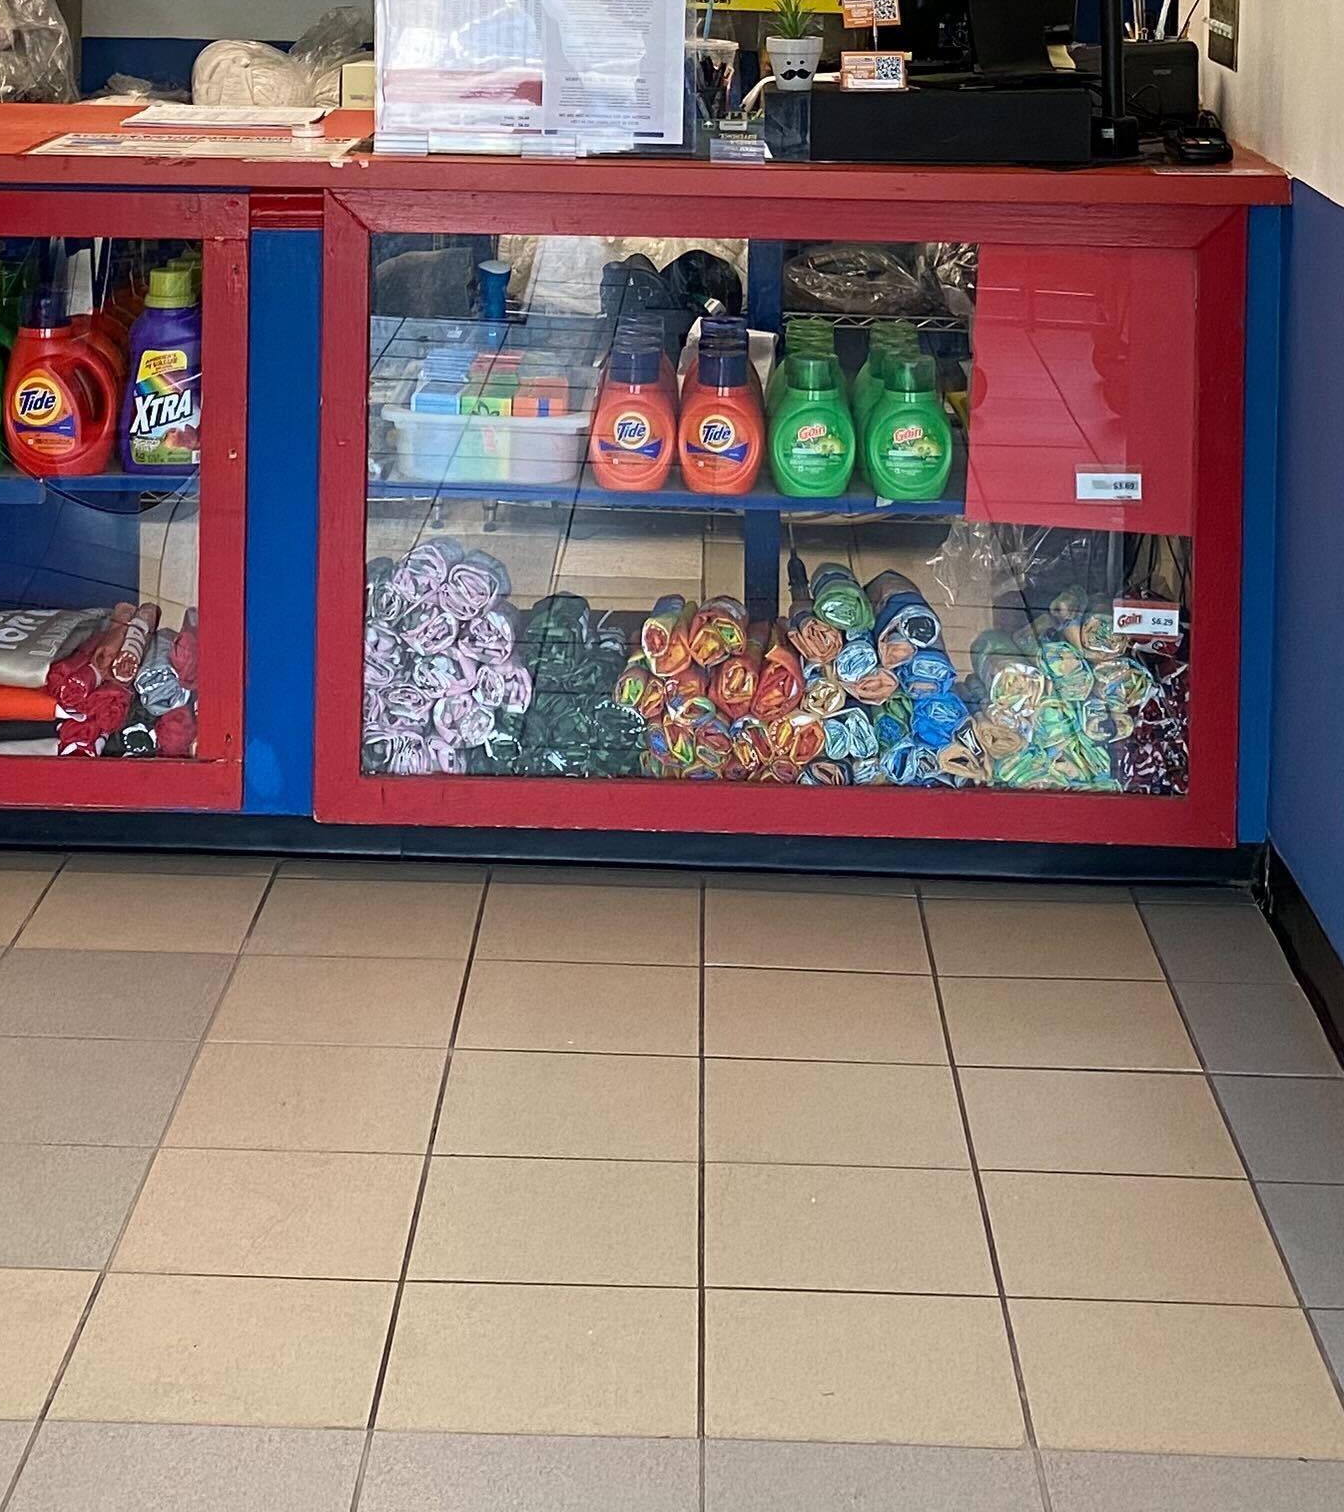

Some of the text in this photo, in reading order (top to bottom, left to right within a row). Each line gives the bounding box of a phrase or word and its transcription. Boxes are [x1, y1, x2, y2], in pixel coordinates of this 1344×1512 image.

[20, 389, 57, 415] Tide
[130, 389, 192, 434] XTRA
[617, 422, 647, 442] Tide
[702, 423, 731, 445] Tide
[799, 424, 826, 440] Gain
[894, 428, 922, 443] Gain
[1118, 613, 1174, 628] Gain $6.29
